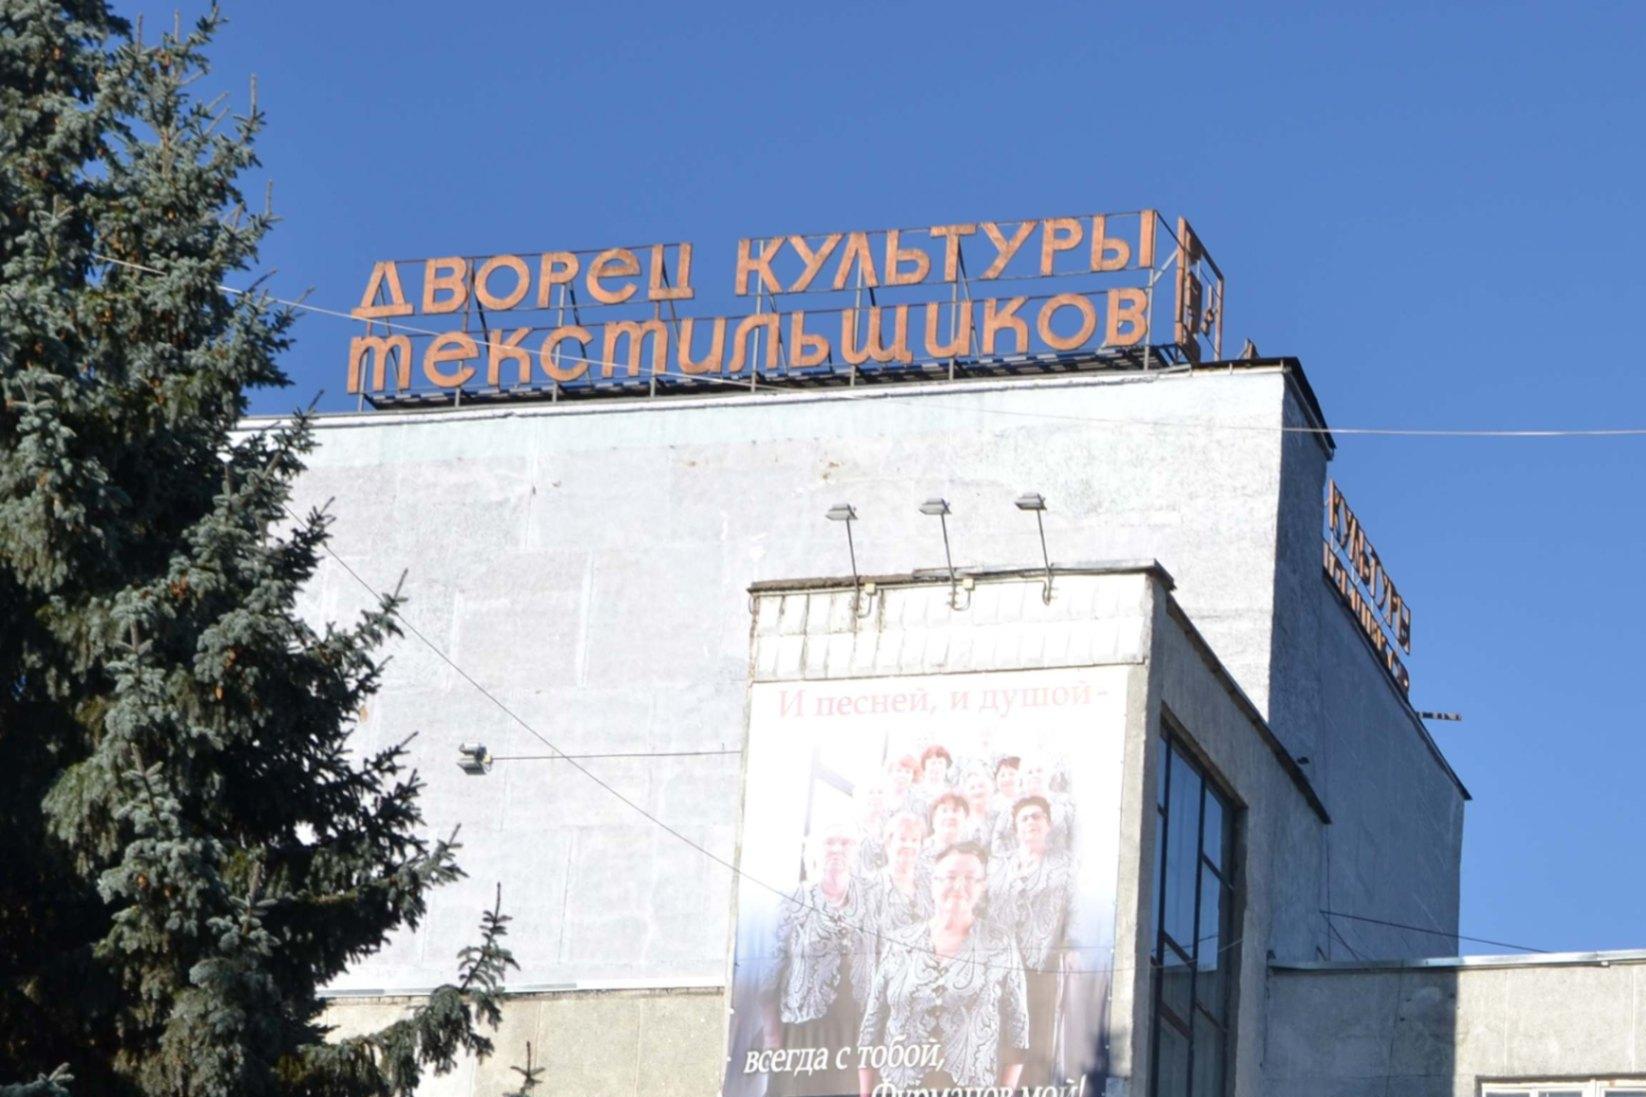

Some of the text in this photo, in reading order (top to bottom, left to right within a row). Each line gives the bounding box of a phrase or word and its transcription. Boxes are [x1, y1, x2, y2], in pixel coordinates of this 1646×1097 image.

[351, 243, 694, 317] ДВОРЕЦ
[735, 209, 1156, 295] КУЛЬТУРЫ
[778, 689, 805, 718] И
[814, 687, 938, 717] песней,
[949, 691, 970, 711] и
[743, 1035, 946, 1076] всегда с тобой,
